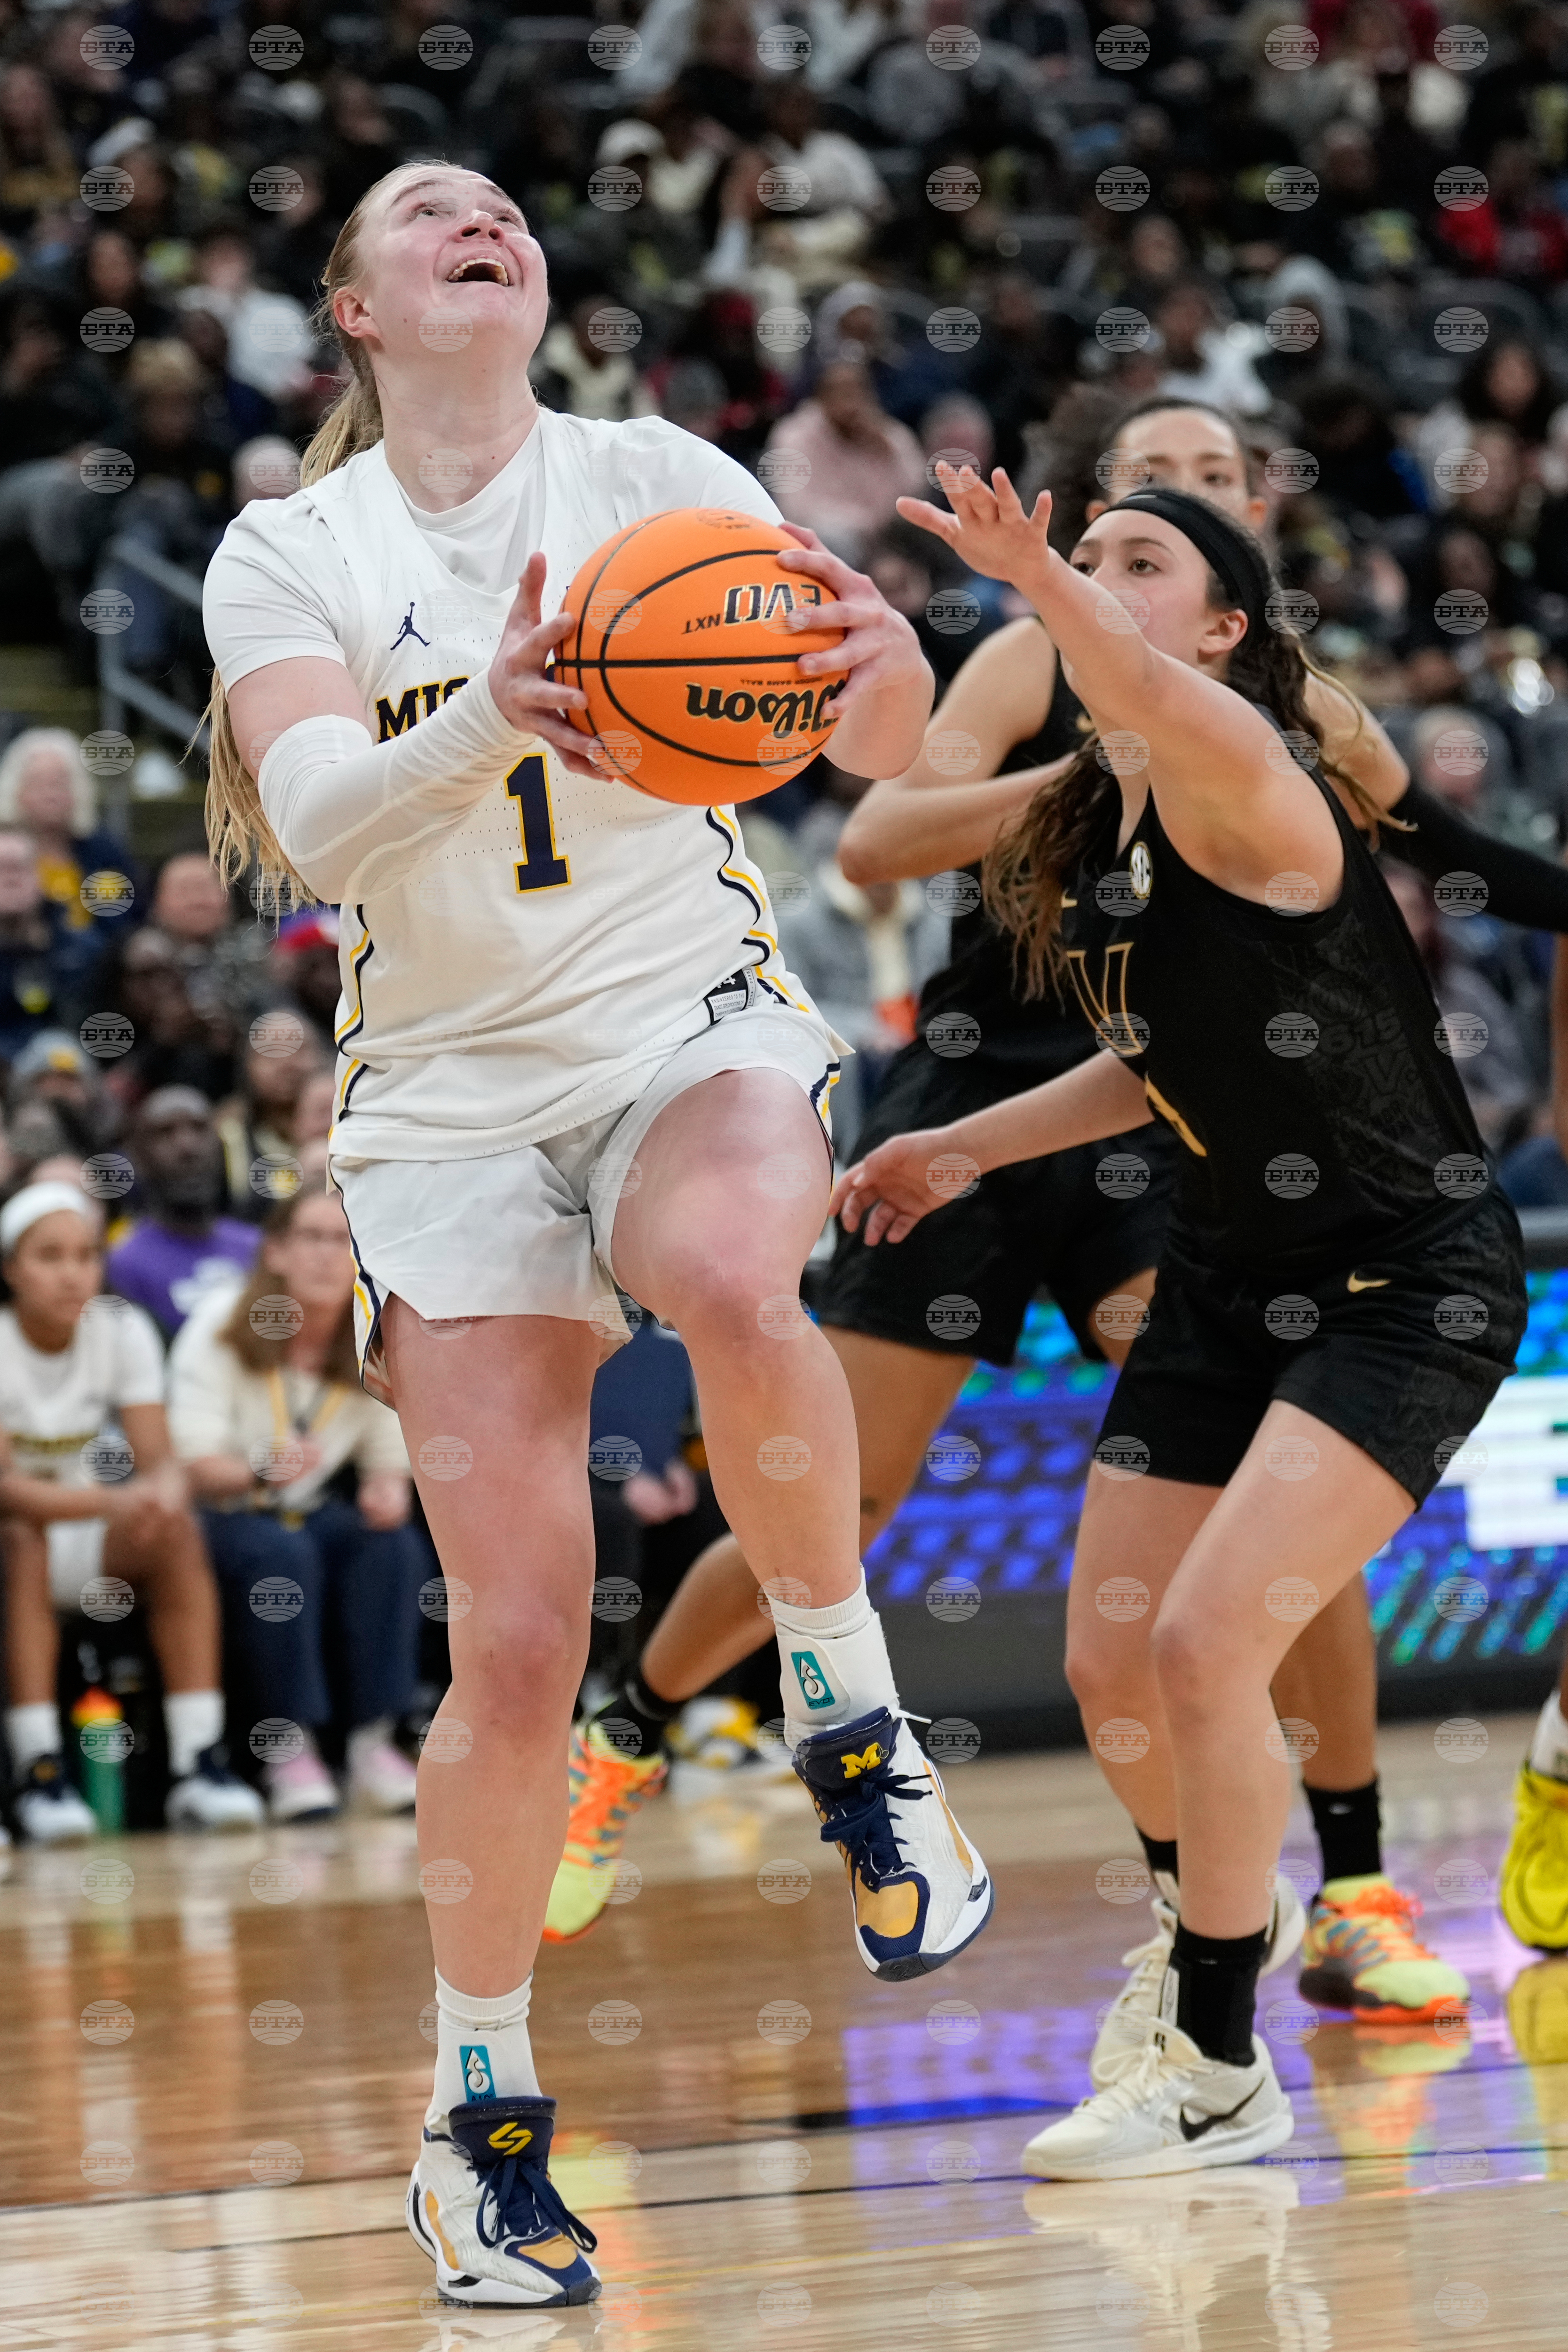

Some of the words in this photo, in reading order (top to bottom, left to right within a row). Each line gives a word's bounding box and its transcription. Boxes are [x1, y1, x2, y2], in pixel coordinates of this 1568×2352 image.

[682, 613, 721, 635] NXT
[503, 752, 572, 894] 1
[841, 1742, 881, 1779] M
